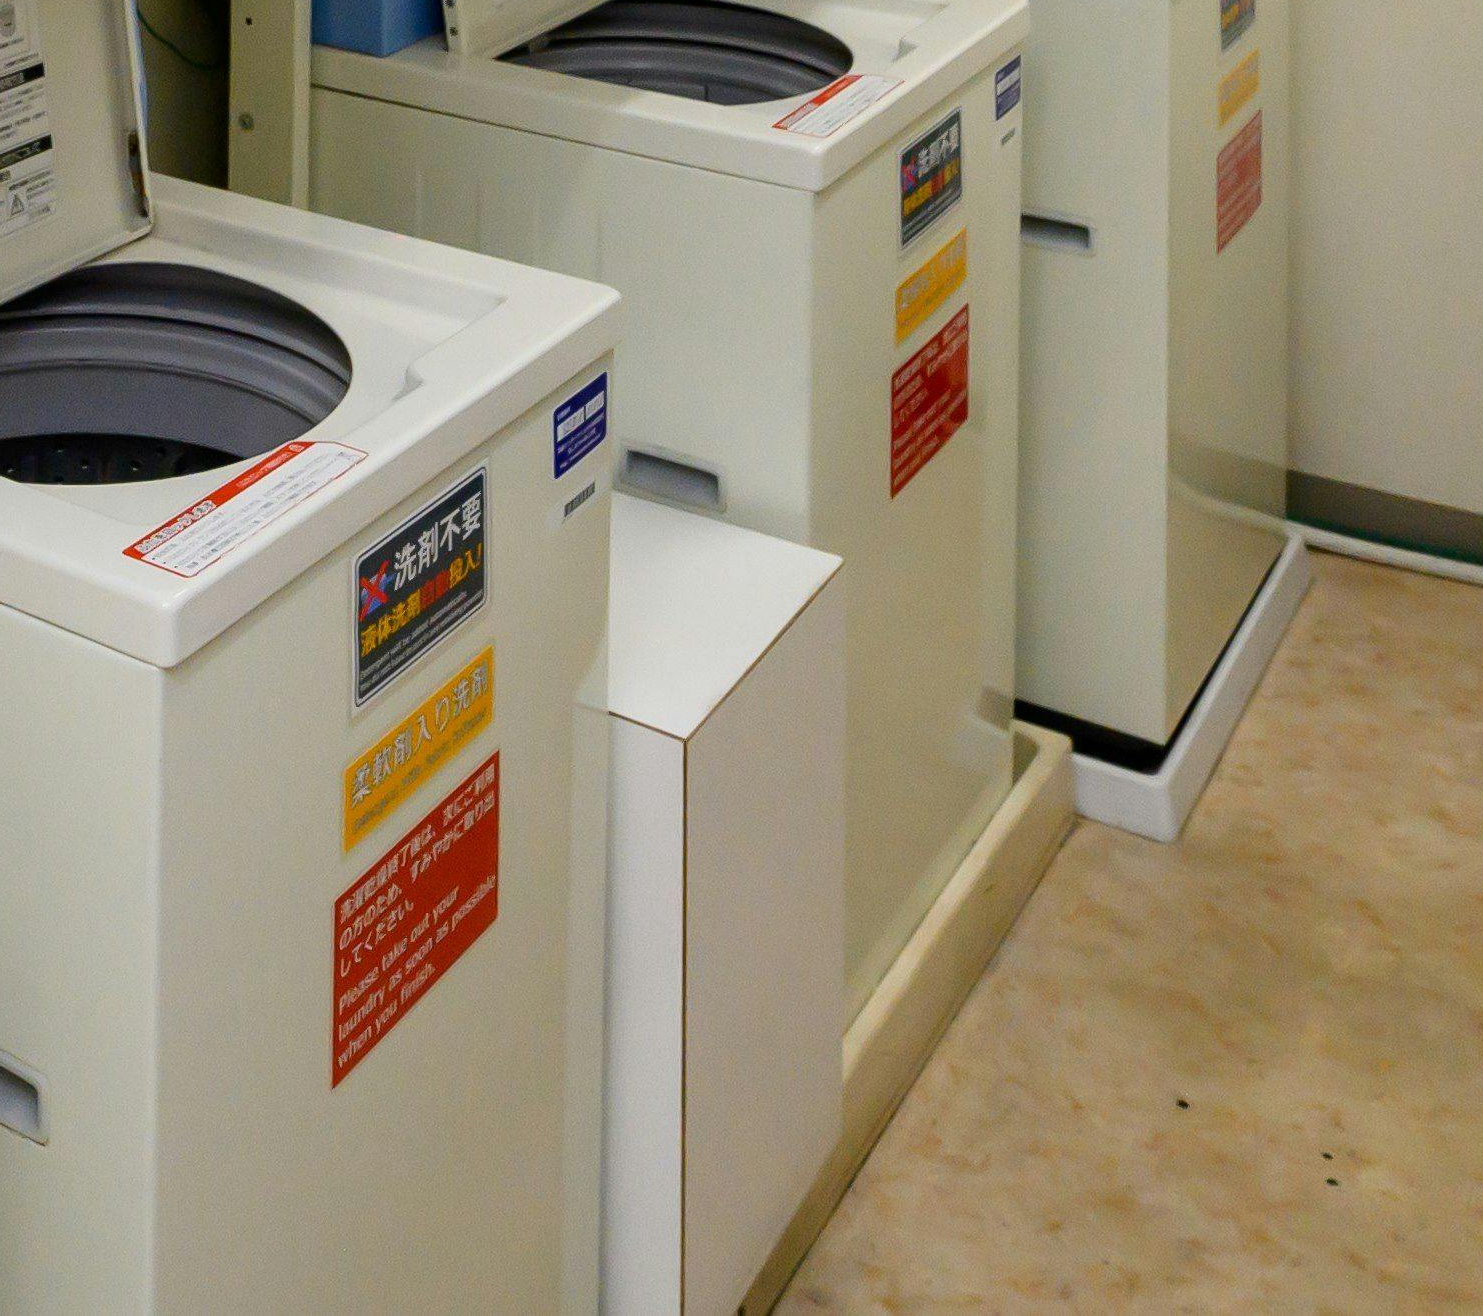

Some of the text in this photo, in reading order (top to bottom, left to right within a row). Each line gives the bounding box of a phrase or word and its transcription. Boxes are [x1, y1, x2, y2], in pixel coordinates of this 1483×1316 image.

[393, 490, 483, 592] 洗剤不要
[350, 667, 488, 809] 柔軟剤入り洗剤
[339, 886, 459, 1015] Please take out your
[339, 988, 385, 1042] laundry
[389, 970, 403, 991] as
[405, 937, 433, 975] soon
[436, 922, 449, 944] as
[337, 1025, 372, 1068] when
[375, 998, 397, 1034] you
